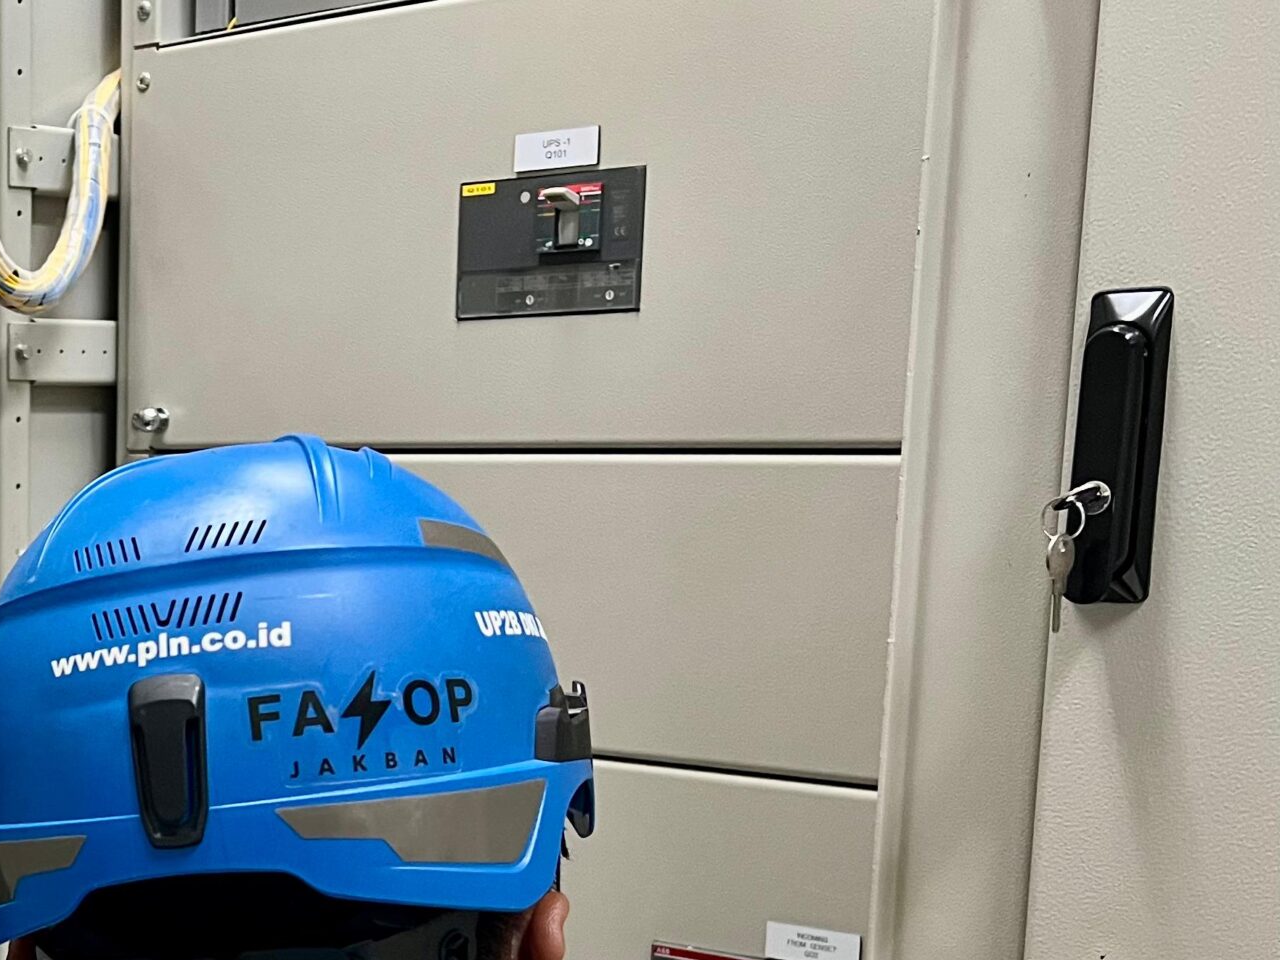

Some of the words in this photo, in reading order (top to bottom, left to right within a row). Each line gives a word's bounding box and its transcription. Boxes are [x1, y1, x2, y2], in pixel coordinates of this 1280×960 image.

[542, 138, 561, 149] UPS
[545, 149, 567, 160] Q101
[474, 610, 523, 637] UP2B
[51, 621, 292, 677] www.pln.co.id
[290, 747, 456, 779] JAKBAN
[787, 938, 807, 948] FROM
